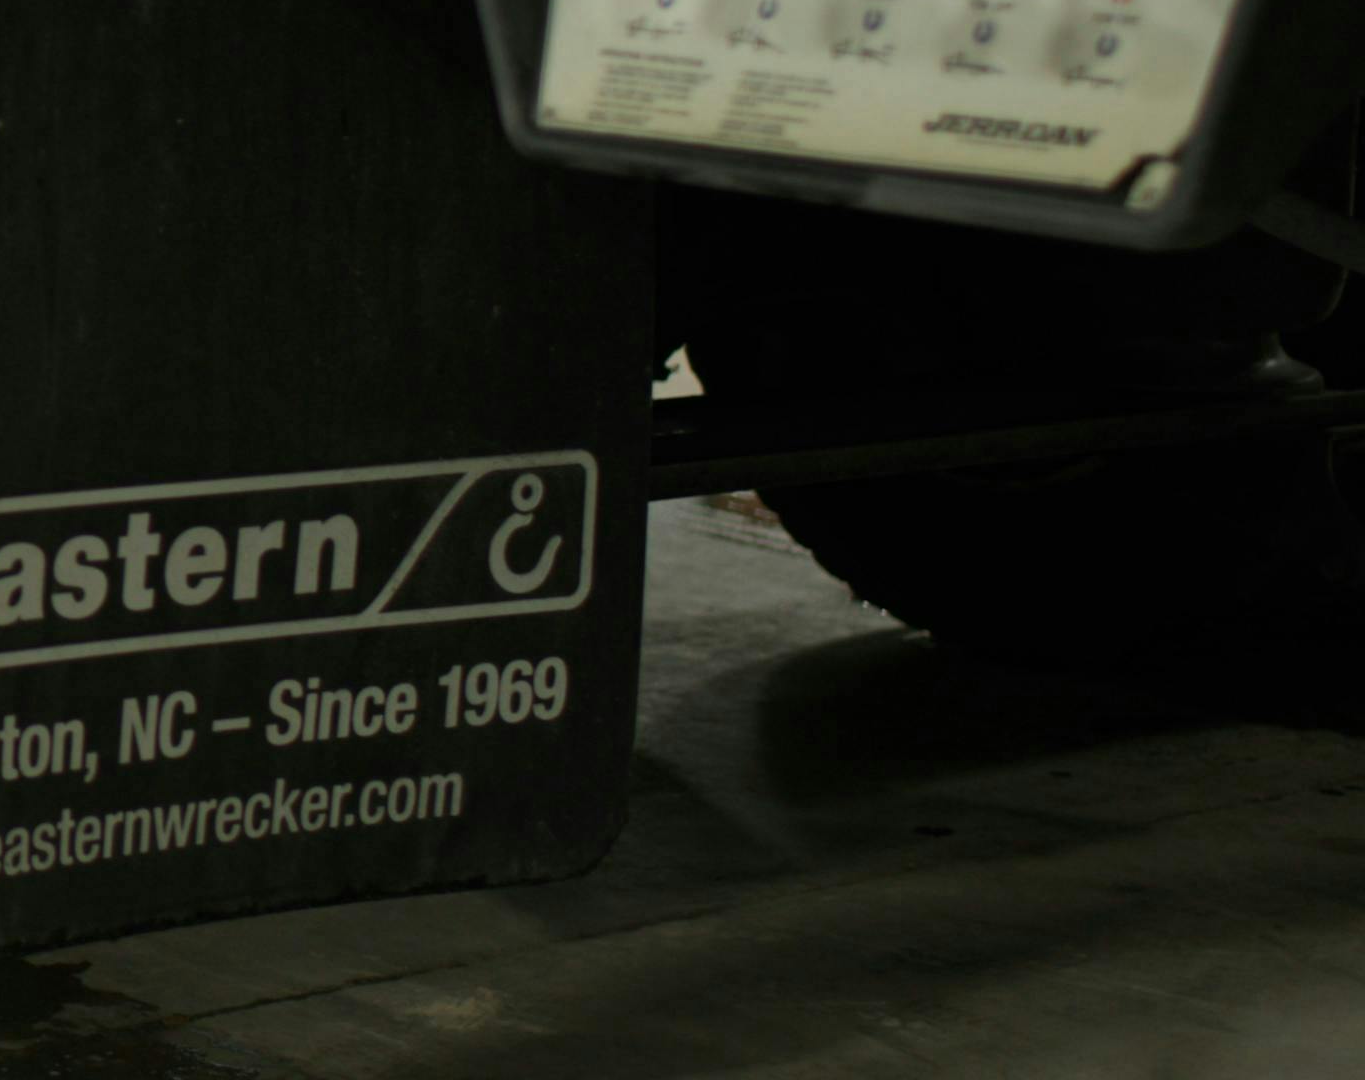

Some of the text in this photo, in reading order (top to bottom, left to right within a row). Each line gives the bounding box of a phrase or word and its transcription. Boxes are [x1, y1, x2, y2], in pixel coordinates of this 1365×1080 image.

[118, 690, 198, 763] NC
[265, 677, 416, 747] Since
[438, 656, 569, 729] 1969
